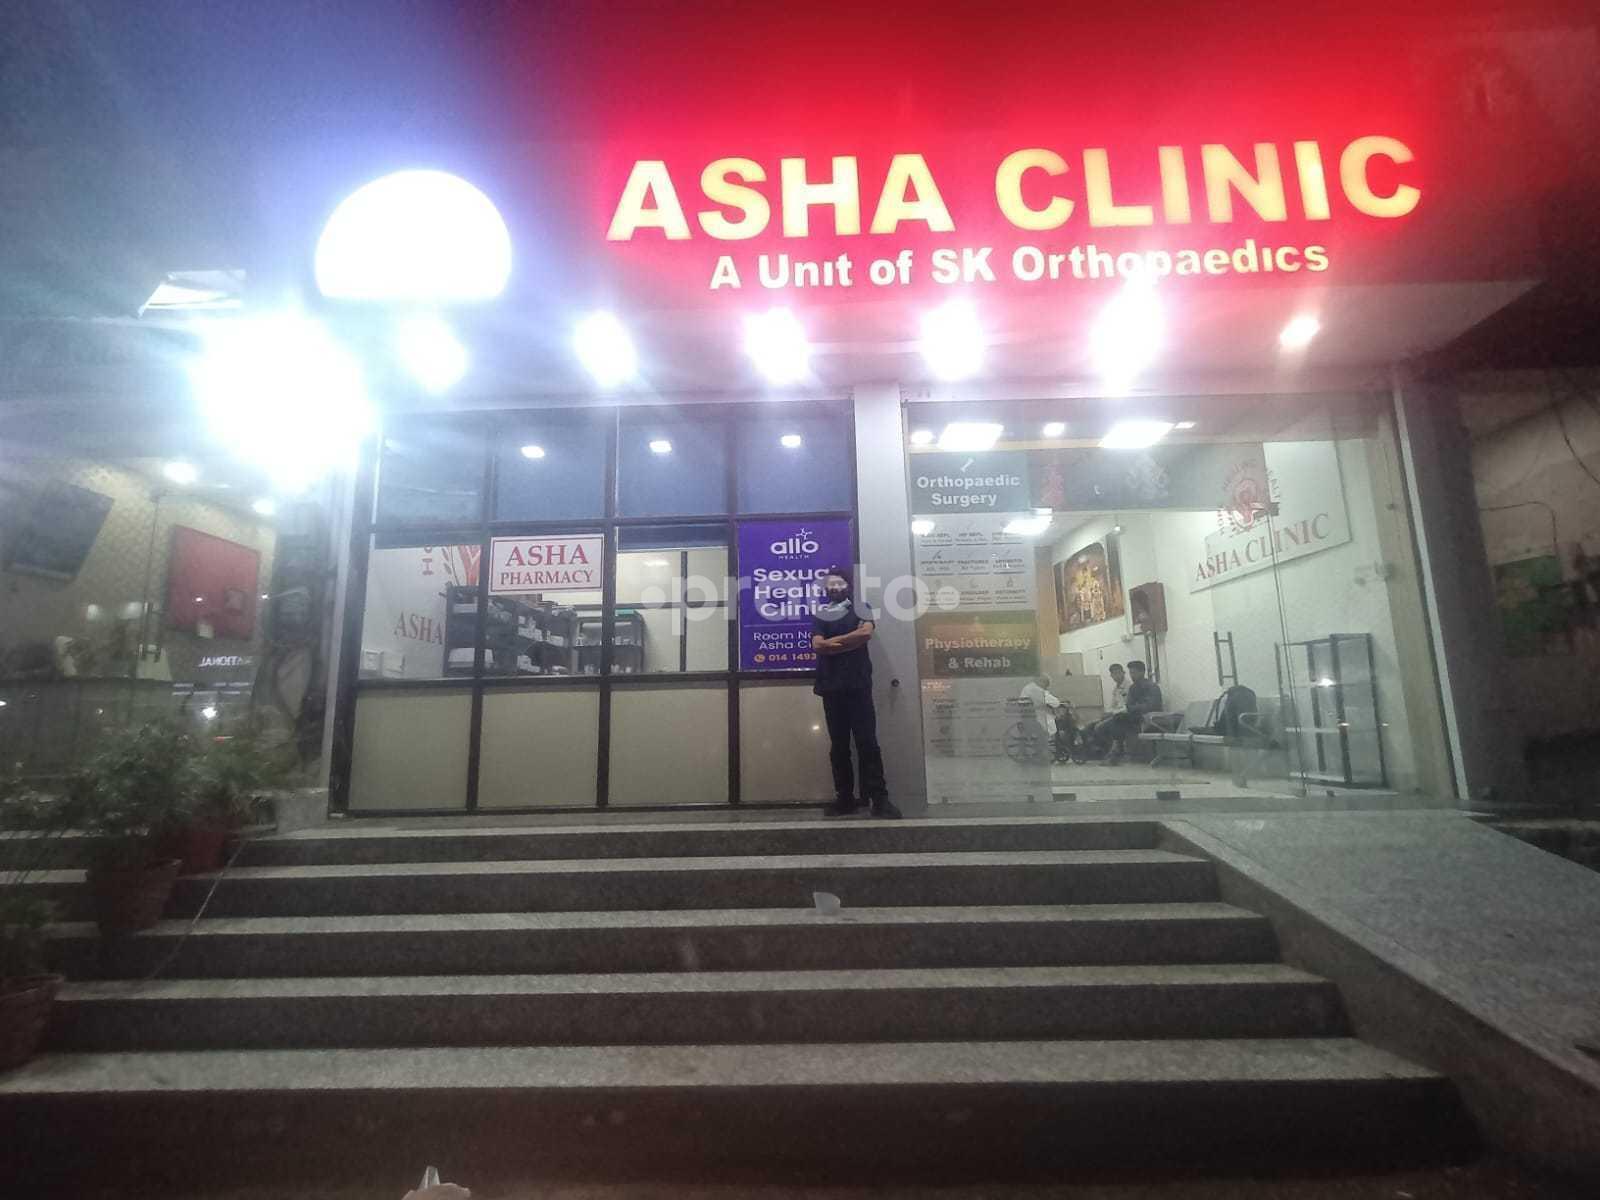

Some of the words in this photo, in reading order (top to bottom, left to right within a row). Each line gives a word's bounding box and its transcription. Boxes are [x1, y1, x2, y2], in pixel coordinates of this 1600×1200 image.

[607, 153, 955, 242] ASHA
[994, 135, 1422, 230] CLINIC
[709, 255, 742, 289] A
[758, 253, 853, 289] Unit
[869, 250, 913, 285] of
[931, 247, 996, 284] SK
[1012, 239, 1329, 282] Orthopaedics
[917, 474, 1021, 489] Orthopaedic
[931, 493, 997, 507] Surgery
[770, 538, 819, 554] allo
[1195, 549, 1241, 582] ASHA
[1245, 513, 1329, 564] CLINIC
[505, 543, 589, 567] ASHA
[499, 569, 594, 586] PHARMACY
[753, 566, 836, 582] Sexua
[393, 611, 444, 646] ASHA
[753, 632, 794, 641] Room
[758, 641, 794, 650] Asha
[925, 637, 1031, 651] Physiotherapy
[948, 657, 959, 669] &
[964, 656, 1011, 669] Rehab
